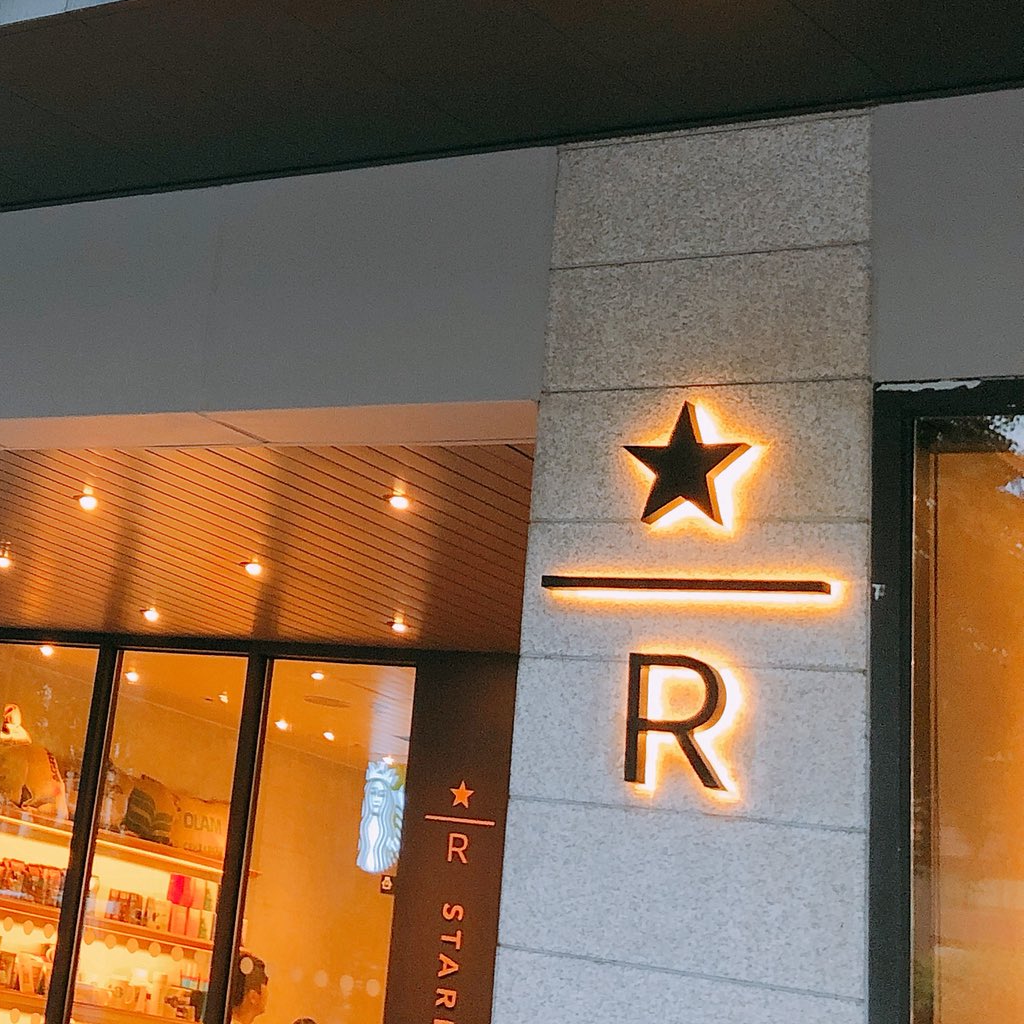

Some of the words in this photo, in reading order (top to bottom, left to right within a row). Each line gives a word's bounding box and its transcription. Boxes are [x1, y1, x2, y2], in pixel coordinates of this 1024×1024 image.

[624, 652, 727, 791] R
[447, 832, 470, 864] R
[433, 902, 465, 1024] STAR
